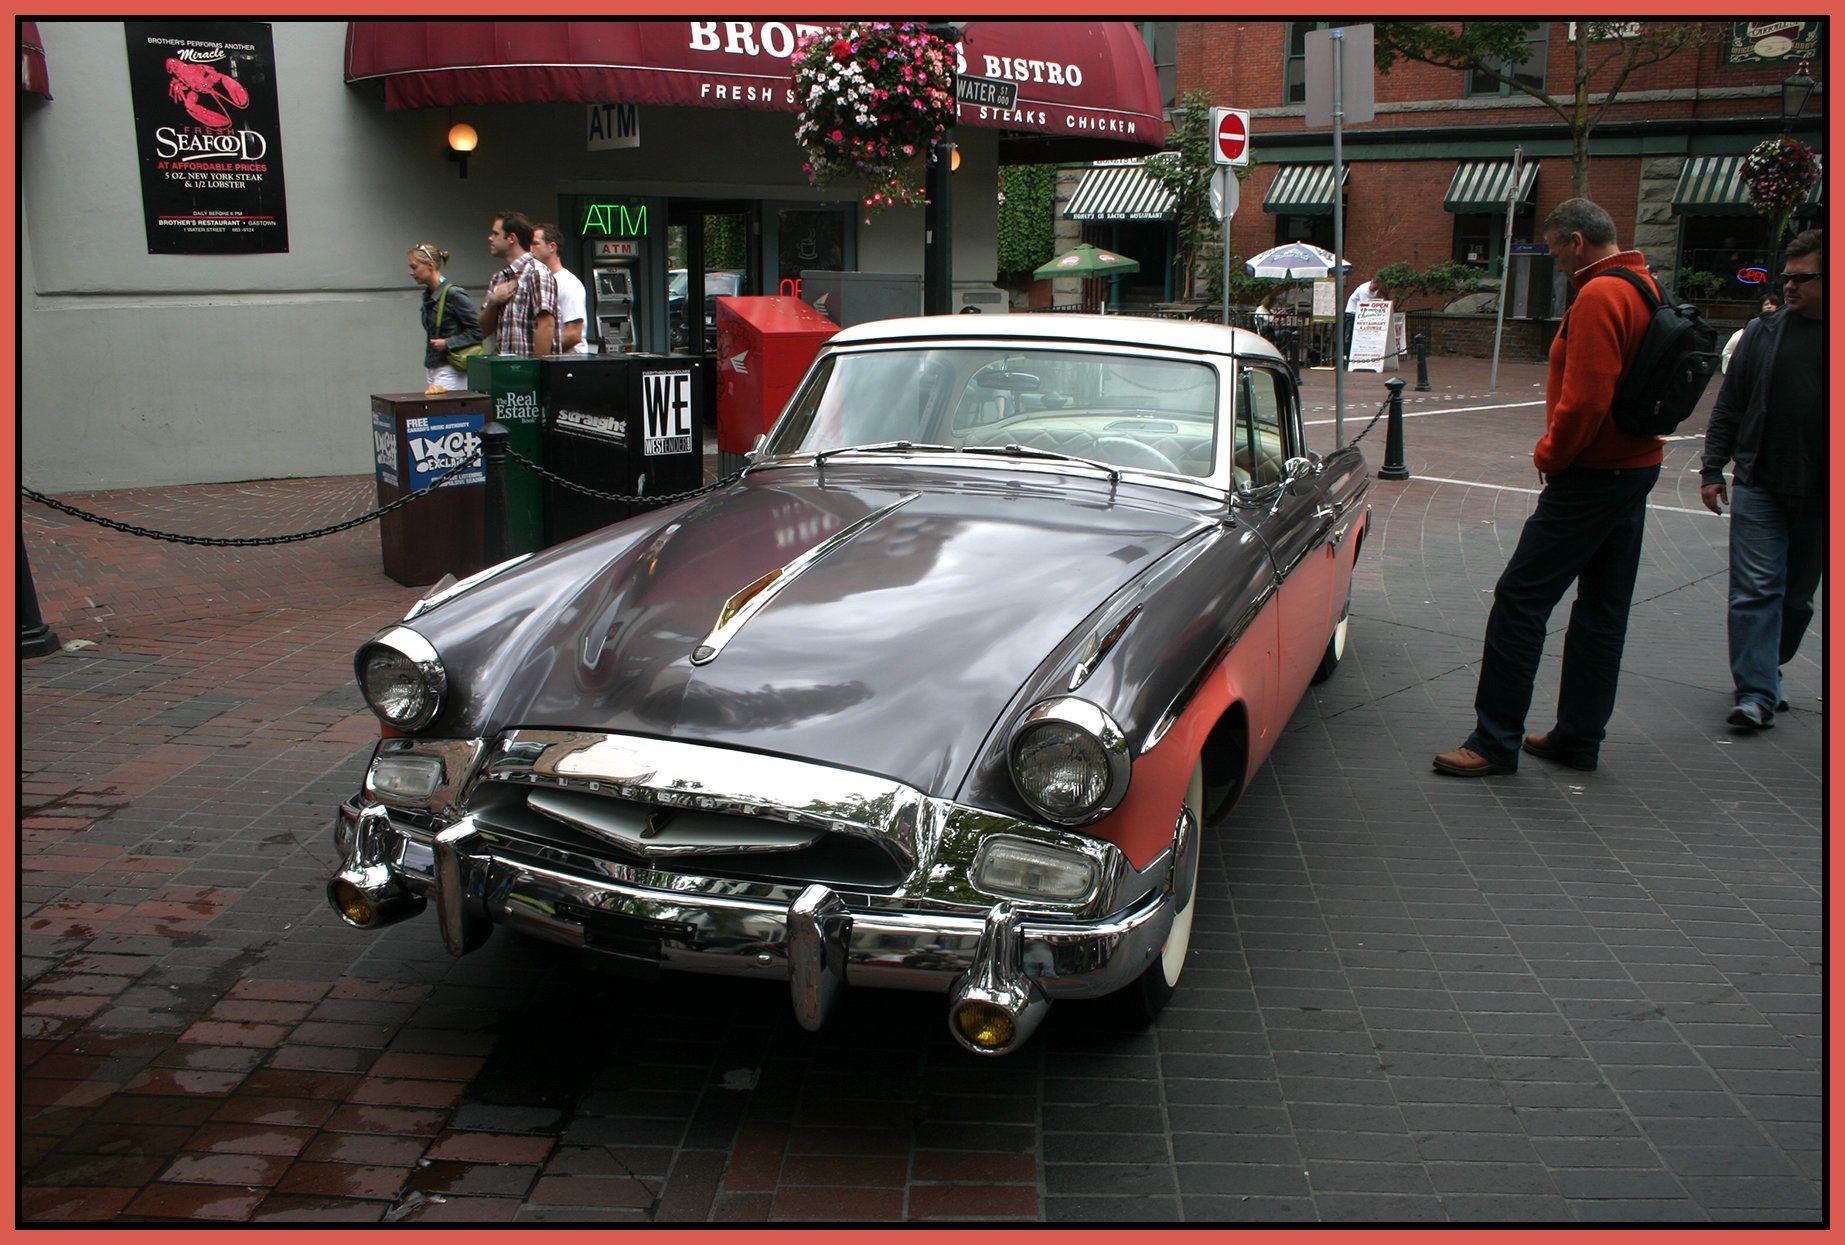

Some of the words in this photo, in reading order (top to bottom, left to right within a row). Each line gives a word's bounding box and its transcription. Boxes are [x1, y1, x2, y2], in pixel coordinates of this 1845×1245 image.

[147, 37, 185, 46] BROTHER'S
[187, 40, 223, 49] PERFORMS
[224, 43, 256, 51] ANOTHER
[177, 48, 227, 62] Miracle
[983, 54, 1083, 87] BISTRO
[957, 79, 996, 104] WATER
[1000, 86, 1009, 96] ST
[701, 83, 772, 102] FRESH
[979, 106, 1046, 125] STEAKS
[1066, 114, 1137, 135] CHICKEN
[183, 125, 235, 136] FRESH
[589, 104, 637, 142] ATM
[158, 161, 170, 170] AT
[171, 161, 233, 171] AFFORDABLE
[234, 162, 268, 172] PRICES
[164, 171, 170, 180] 5
[171, 172, 186, 180] OZ.
[187, 172, 209, 180] NEW
[210, 172, 235, 181] YORK
[236, 173, 263, 181] STEAK
[208, 181, 246, 189] LOBSTER
[582, 203, 647, 236] ATM
[602, 244, 632, 254] ATM
[1738, 268, 1768, 284] OPEN
[496, 397, 508, 405] The
[507, 390, 538, 407] Real
[644, 375, 690, 437] WE
[496, 404, 540, 420] Estate
[406, 417, 428, 428] FREE
[558, 408, 628, 433] straight
[645, 437, 688, 454] WESTENDER
